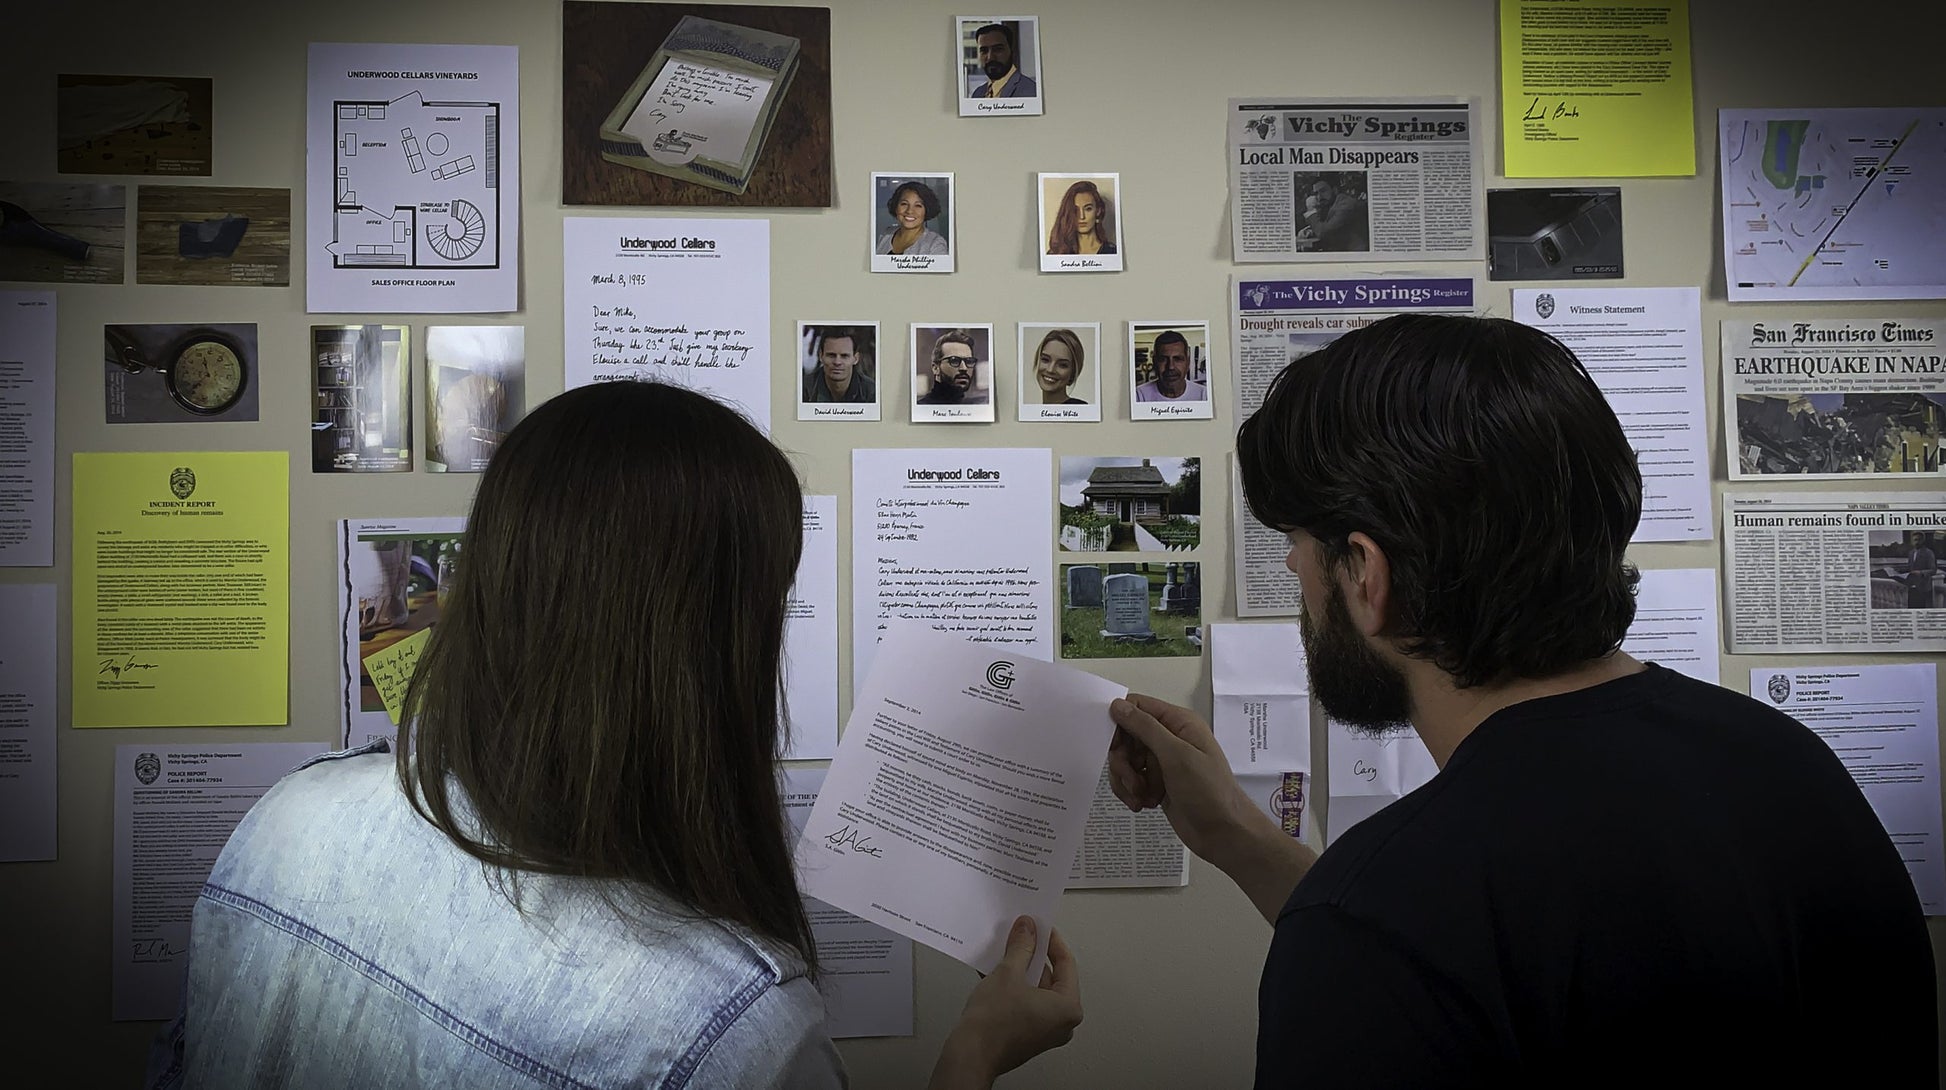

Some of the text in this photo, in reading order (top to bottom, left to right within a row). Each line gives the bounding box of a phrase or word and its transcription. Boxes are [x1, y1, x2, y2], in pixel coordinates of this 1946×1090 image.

[347, 71, 478, 80] UNDERWOOD CELLARS VINEYARDS
[977, 103, 1025, 112] Cary Underwood
[1342, 114, 1362, 122] The
[1288, 115, 1467, 137] Vichy Springs
[1393, 133, 1435, 141] Register
[1240, 148, 1420, 168] Local Man Disappears
[620, 236, 716, 250] Underwood Cellars
[890, 256, 935, 265] Marsha Phillips
[1060, 260, 1103, 268] Sandra Bellini
[591, 274, 646, 287] March 8, 1995
[1273, 285, 1469, 304] The Vichy Springs Register
[593, 305, 637, 319] Dear Mike,
[1569, 305, 1646, 314] Witness Statement
[1240, 317, 1284, 332] Drought
[1286, 316, 1324, 330] reveals
[1326, 319, 1344, 329] car
[593, 322, 612, 335] Sure,
[629, 325, 641, 334] can
[694, 329, 710, 340] your
[713, 329, 731, 341] group
[1751, 321, 1934, 347] San Francisco Times
[592, 336, 625, 353] Thursday
[630, 339, 643, 350] the
[669, 337, 683, 353] Just
[686, 343, 700, 354] give
[706, 344, 718, 355] my
[721, 342, 753, 360] secretary
[593, 353, 622, 365] Elouise
[632, 354, 648, 364] call
[653, 355, 667, 365] and
[694, 353, 721, 369] handle
[724, 358, 740, 368] the
[1734, 356, 1870, 378] EARTHQUAKE
[1875, 356, 1896, 374] IN
[814, 407, 865, 416] David Underwood
[1040, 409, 1079, 418] Elouise White
[1150, 406, 1170, 416] Miguel
[907, 468, 1000, 482] Underwood Cellars
[1734, 514, 1784, 527] Human
[1788, 514, 1842, 526] remains
[1846, 513, 1885, 526] found
[1889, 513, 1901, 526] in
[884, 697, 906, 709] September
[1353, 759, 1377, 782] Cary
